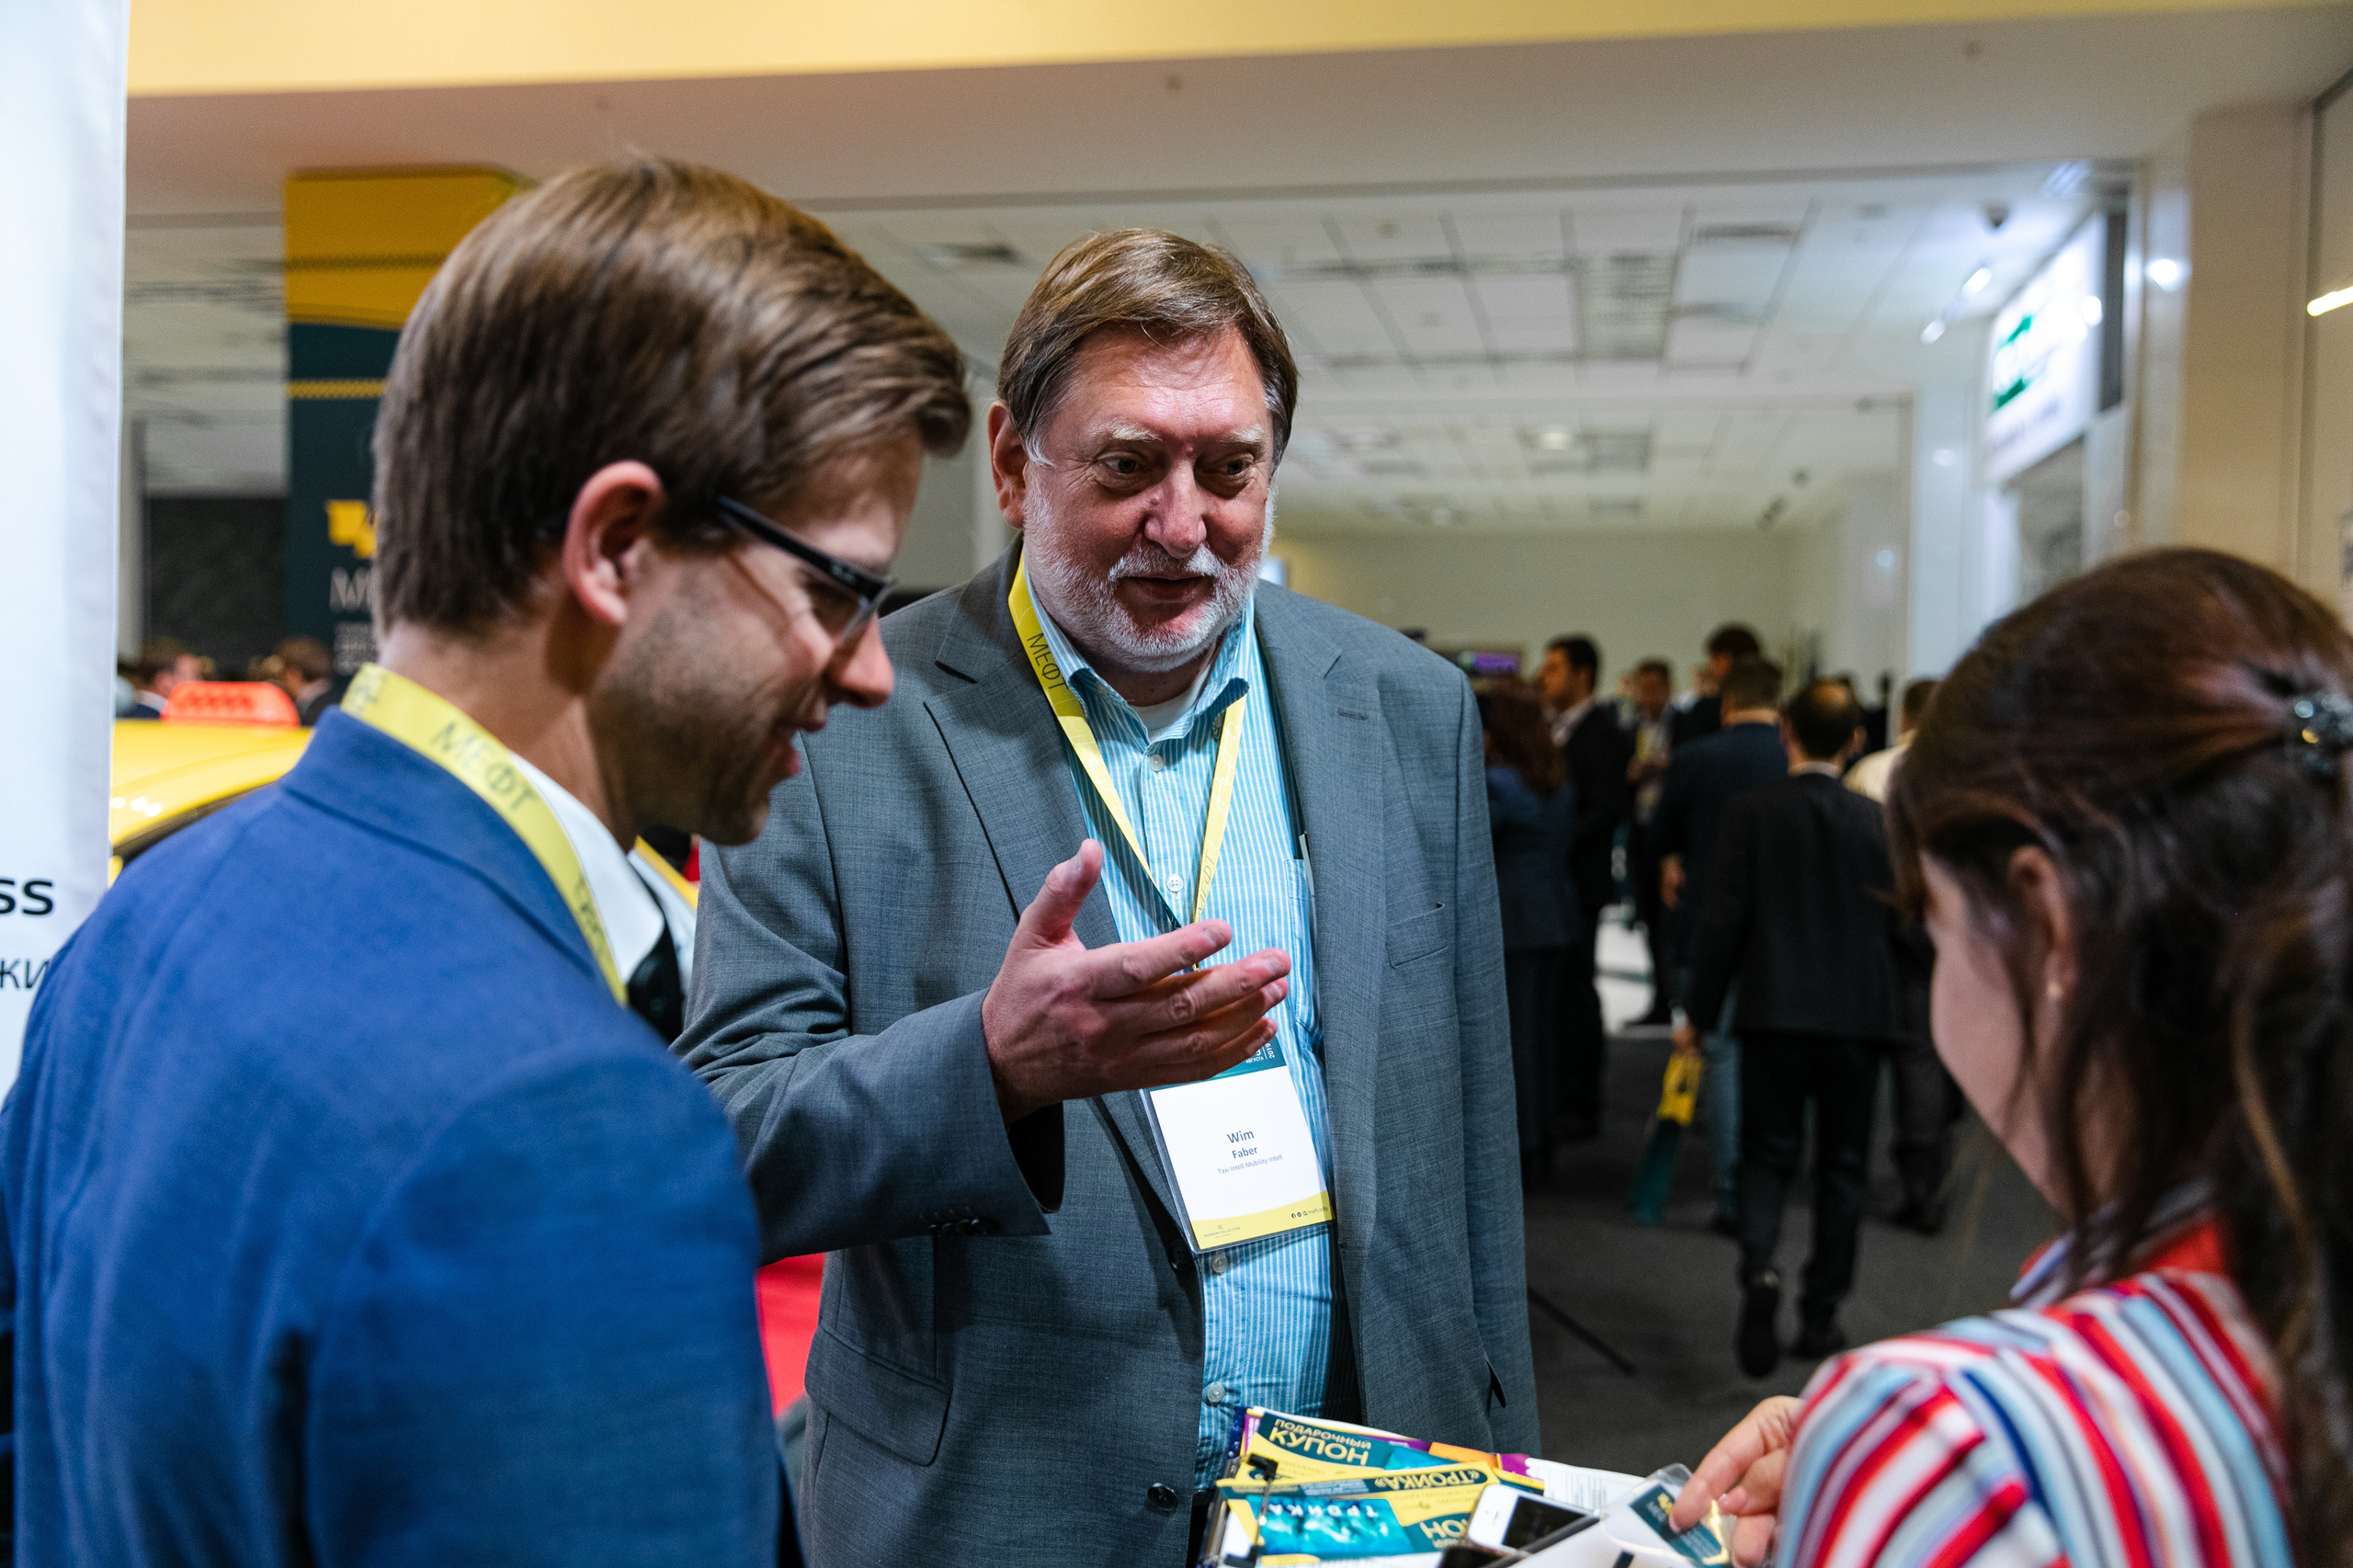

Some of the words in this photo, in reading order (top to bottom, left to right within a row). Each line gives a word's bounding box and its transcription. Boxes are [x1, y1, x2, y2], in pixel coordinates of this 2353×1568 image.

[1027, 632, 1069, 690] МЕФТ
[430, 722, 536, 812] МЕФТ
[1265, 1042, 1276, 1059] 2019
[1226, 1131, 1255, 1143] Wim
[1230, 1158, 1268, 1172] Intell-Mobility
[1268, 1153, 1283, 1163] Intell
[1232, 1147, 1257, 1159] Faber
[1274, 1418, 1371, 1449] ПОДАРОЧНЫЙ
[1268, 1426, 1370, 1466] КУПОН
[1374, 1470, 1481, 1491] «ТРОЙКА»
